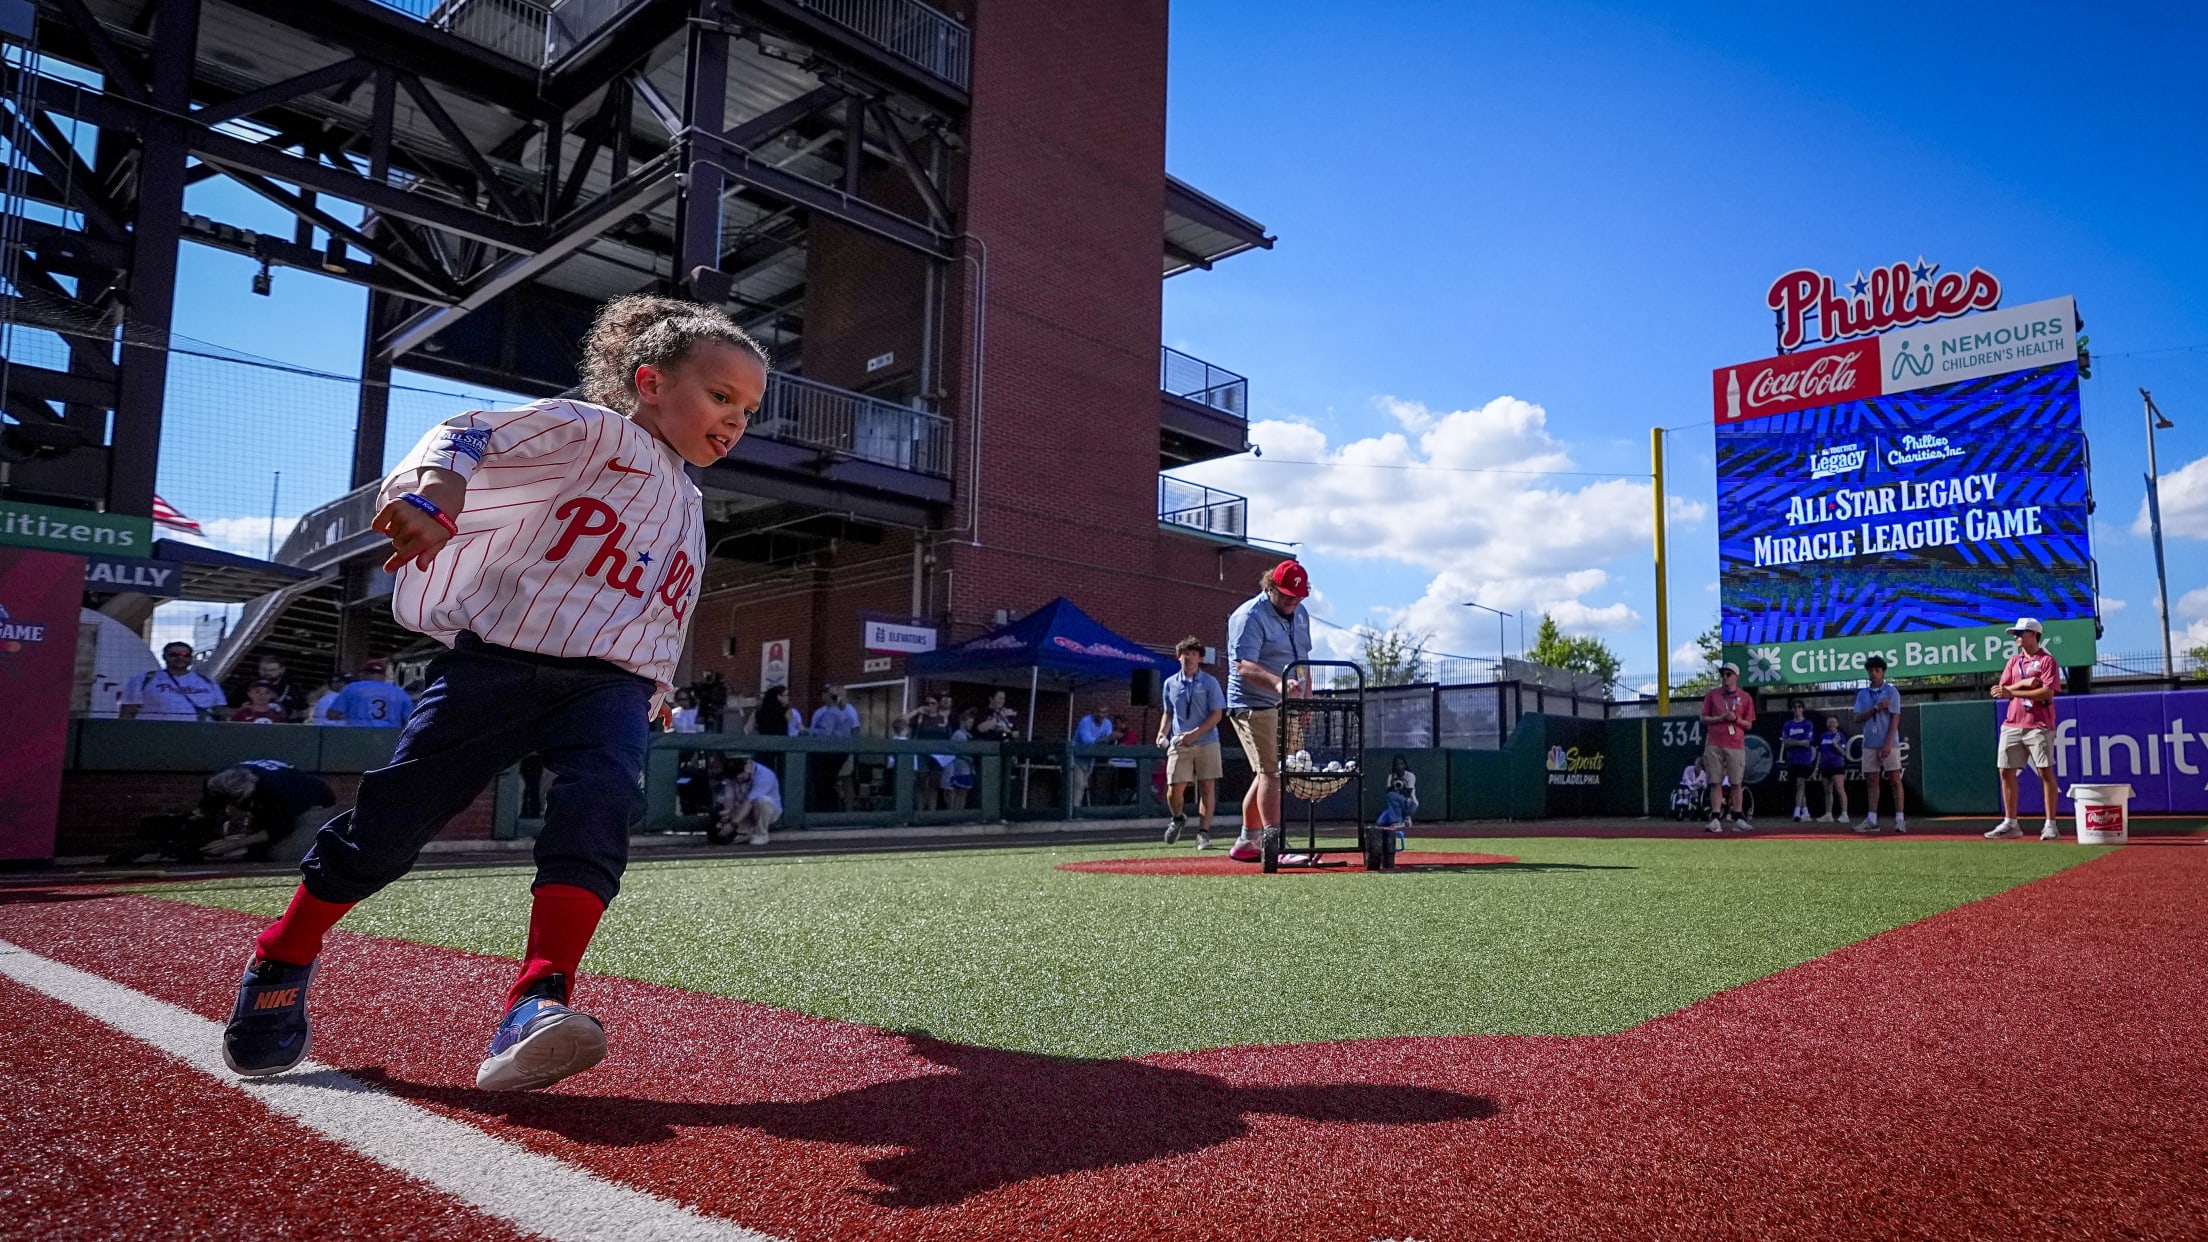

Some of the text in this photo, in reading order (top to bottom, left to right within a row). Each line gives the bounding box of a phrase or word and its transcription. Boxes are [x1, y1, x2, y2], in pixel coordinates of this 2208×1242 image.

[1767, 260, 2001, 349] Phillies
[1942, 318, 2063, 355] NEMOURS
[1942, 337, 2065, 372] CHILDREN'S HEALTH
[1747, 350, 1863, 408] Coca-Cola
[1902, 434, 1949, 451] Phillies
[1810, 449, 1867, 479] Legacy
[1785, 473, 1998, 526] ALL STAR LEGACY
[0, 511, 134, 546] itizens
[1753, 506, 2042, 568] MIRACLE LEAGUE GAME
[84, 563, 172, 588] ALLY
[545, 497, 695, 630] Philli
[1294, 576, 1302, 587] P
[1905, 636, 1977, 667] Bank
[1985, 636, 2052, 661] Pak
[370, 699, 386, 720] 3
[1662, 720, 1702, 747] 334
[1566, 746, 1605, 774] Sports
[2016, 718, 2208, 792] finit
[1548, 773, 1600, 785] PHILADELPHIA
[254, 987, 300, 1011] NIKE
